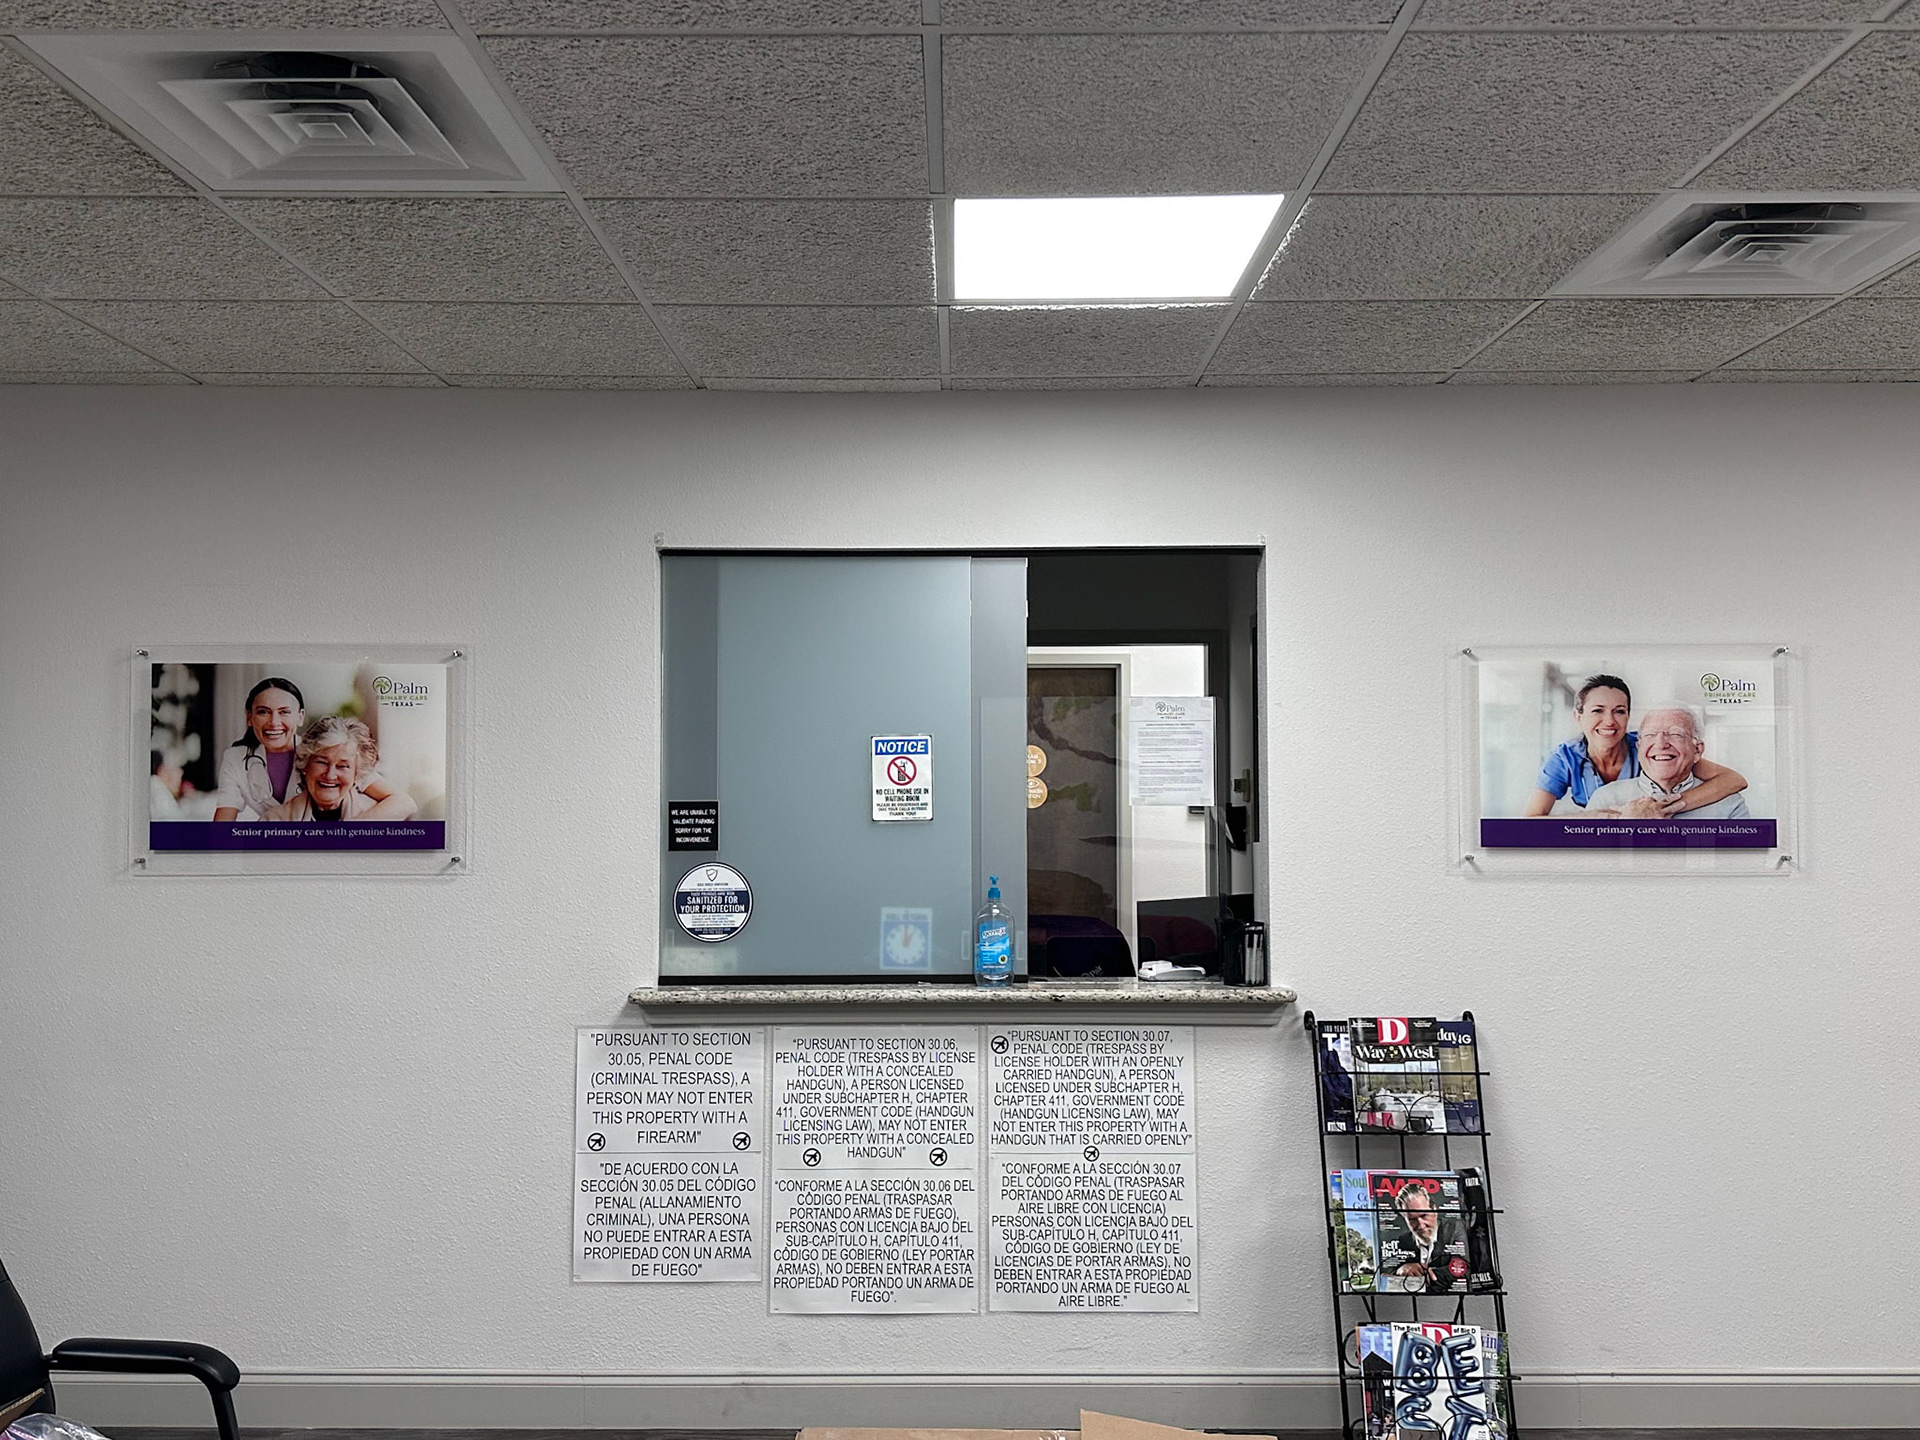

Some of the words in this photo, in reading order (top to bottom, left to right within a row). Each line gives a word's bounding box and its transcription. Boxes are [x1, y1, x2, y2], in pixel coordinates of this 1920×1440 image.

[394, 682, 428, 694] Palm
[1721, 679, 1756, 691] Palm
[877, 741, 926, 753] NOTICE
[232, 827, 262, 836] Senior
[264, 828, 303, 838] primary
[326, 827, 346, 836] with
[348, 828, 385, 838] genuine
[386, 827, 425, 836] kindness
[1564, 825, 1594, 834] Senior
[1597, 826, 1635, 836] primary
[1659, 825, 1679, 834] with
[1681, 825, 1716, 836] genuine
[1718, 825, 1757, 834] kindness
[687, 896, 722, 904] SANITIZED
[724, 896, 738, 904] FOR
[680, 905, 700, 913] YOUR
[702, 905, 745, 913] PROTECTION
[1379, 1018, 1407, 1043] D
[672, 1033, 689, 1046] TO
[692, 1033, 751, 1046] SECTION
[1076, 1031, 1089, 1041] TO
[1091, 1031, 1140, 1041] SECTION
[1142, 1031, 1173, 1044] 30.07,
[861, 1039, 874, 1049] TO
[877, 1039, 925, 1049] SECTION
[928, 1039, 959, 1052] 30.06,
[1013, 1043, 1050, 1054] PENAL
[1051, 1043, 1083, 1054] CODE
[1086, 1043, 1147, 1056] (TRESPASS
[1150, 1043, 1165, 1054] BY
[775, 1052, 811, 1063] PENAL
[814, 1052, 845, 1063] CODE
[848, 1052, 909, 1065] (TRESPASS
[912, 1052, 926, 1063] BY
[929, 1052, 976, 1063] LICENSE
[1355, 1046, 1387, 1061] Way
[1398, 1045, 1435, 1059] West
[608, 1053, 645, 1066] 30.05,
[649, 1053, 692, 1064] PENAL
[695, 1053, 732, 1064] CODE
[994, 1056, 1041, 1067] LICENSE
[1044, 1056, 1089, 1067] HOLDER
[1092, 1056, 1120, 1067] WITH
[1122, 1056, 1137, 1067] AN
[1140, 1056, 1184, 1067] OPENLY
[797, 1065, 843, 1077] HOLDER
[846, 1065, 874, 1077] WITH
[876, 1065, 884, 1077] A
[886, 1065, 953, 1077] CONCEALED
[591, 1072, 658, 1088] (CRIMINAL
[662, 1072, 738, 1088] TRESPASS),
[741, 1072, 750, 1085] A
[787, 1079, 848, 1092] HANDGUN),
[850, 1079, 859, 1090] A
[860, 1079, 906, 1090] PERSON
[910, 1079, 964, 1090] LICENSED
[587, 1092, 642, 1104] PERSON
[646, 1092, 674, 1104] MAY
[677, 1092, 707, 1104] NOT
[708, 1092, 753, 1104] ENTER
[593, 1111, 622, 1124] THIS
[626, 1111, 698, 1124] PROPERTY
[702, 1111, 735, 1124] WITH
[738, 1111, 747, 1124] A
[624, 1163, 688, 1175] ACUERDO
[691, 1163, 719, 1175] CON
[723, 1163, 738, 1175] LA
[581, 1176, 638, 1192] SECCIÓN
[642, 1180, 674, 1192] 30.05
[677, 1180, 702, 1192] DEL
[705, 1176, 756, 1192] CÓDIGO
[1377, 1177, 1440, 1197] AAP
[595, 1196, 636, 1208] PENAL
[639, 1196, 741, 1210] (ALLANAMIENTO
[587, 1213, 654, 1228] CRIMINAL),
[659, 1213, 686, 1225] UNA
[688, 1213, 749, 1226] PERSONA
[584, 1230, 602, 1242] NO
[606, 1230, 650, 1242] PUEDE
[654, 1230, 706, 1242] ENTRAR
[708, 1230, 717, 1242] A
[720, 1230, 752, 1242] ESTA
[1381, 1240, 1399, 1249] Jeff
[584, 1247, 659, 1259] PROPIEDAD
[662, 1247, 690, 1259] CON
[691, 1247, 712, 1259] UN
[713, 1247, 751, 1259] ARMA
[1382, 1249, 1416, 1259] Bridges
[632, 1264, 649, 1276] DE
